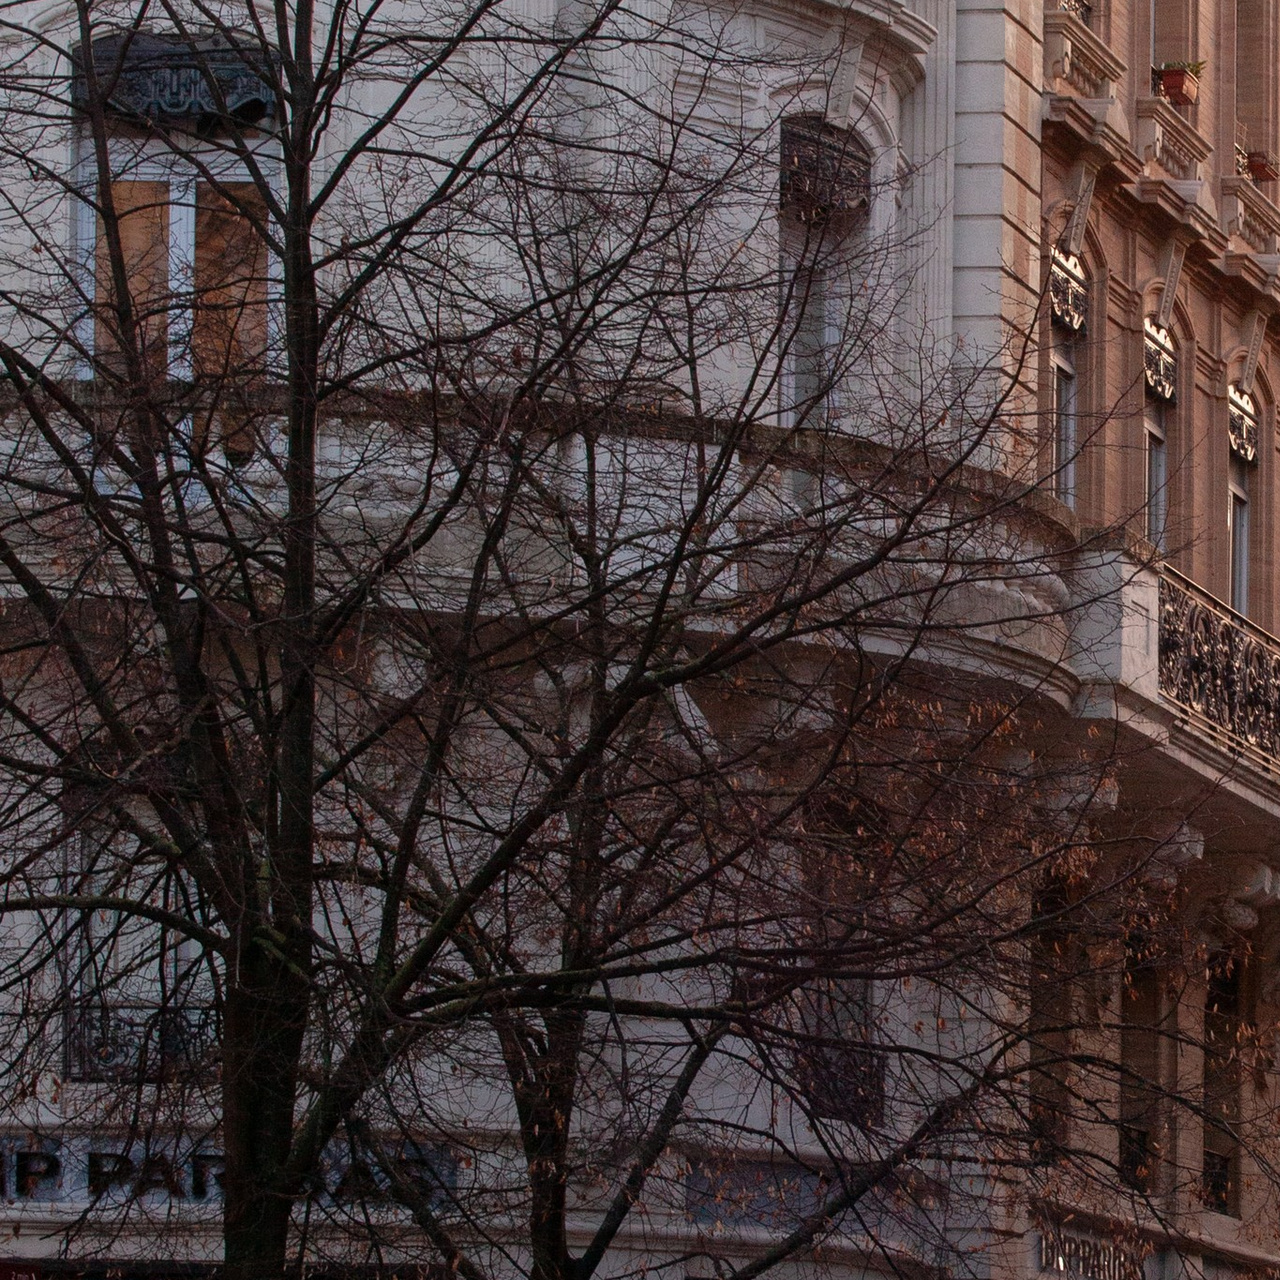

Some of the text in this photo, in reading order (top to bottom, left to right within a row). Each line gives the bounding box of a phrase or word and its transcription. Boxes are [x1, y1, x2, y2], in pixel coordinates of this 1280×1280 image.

[0, 1152, 436, 1198] P PARAS
[11, 1271, 30, 1280] 2 min
